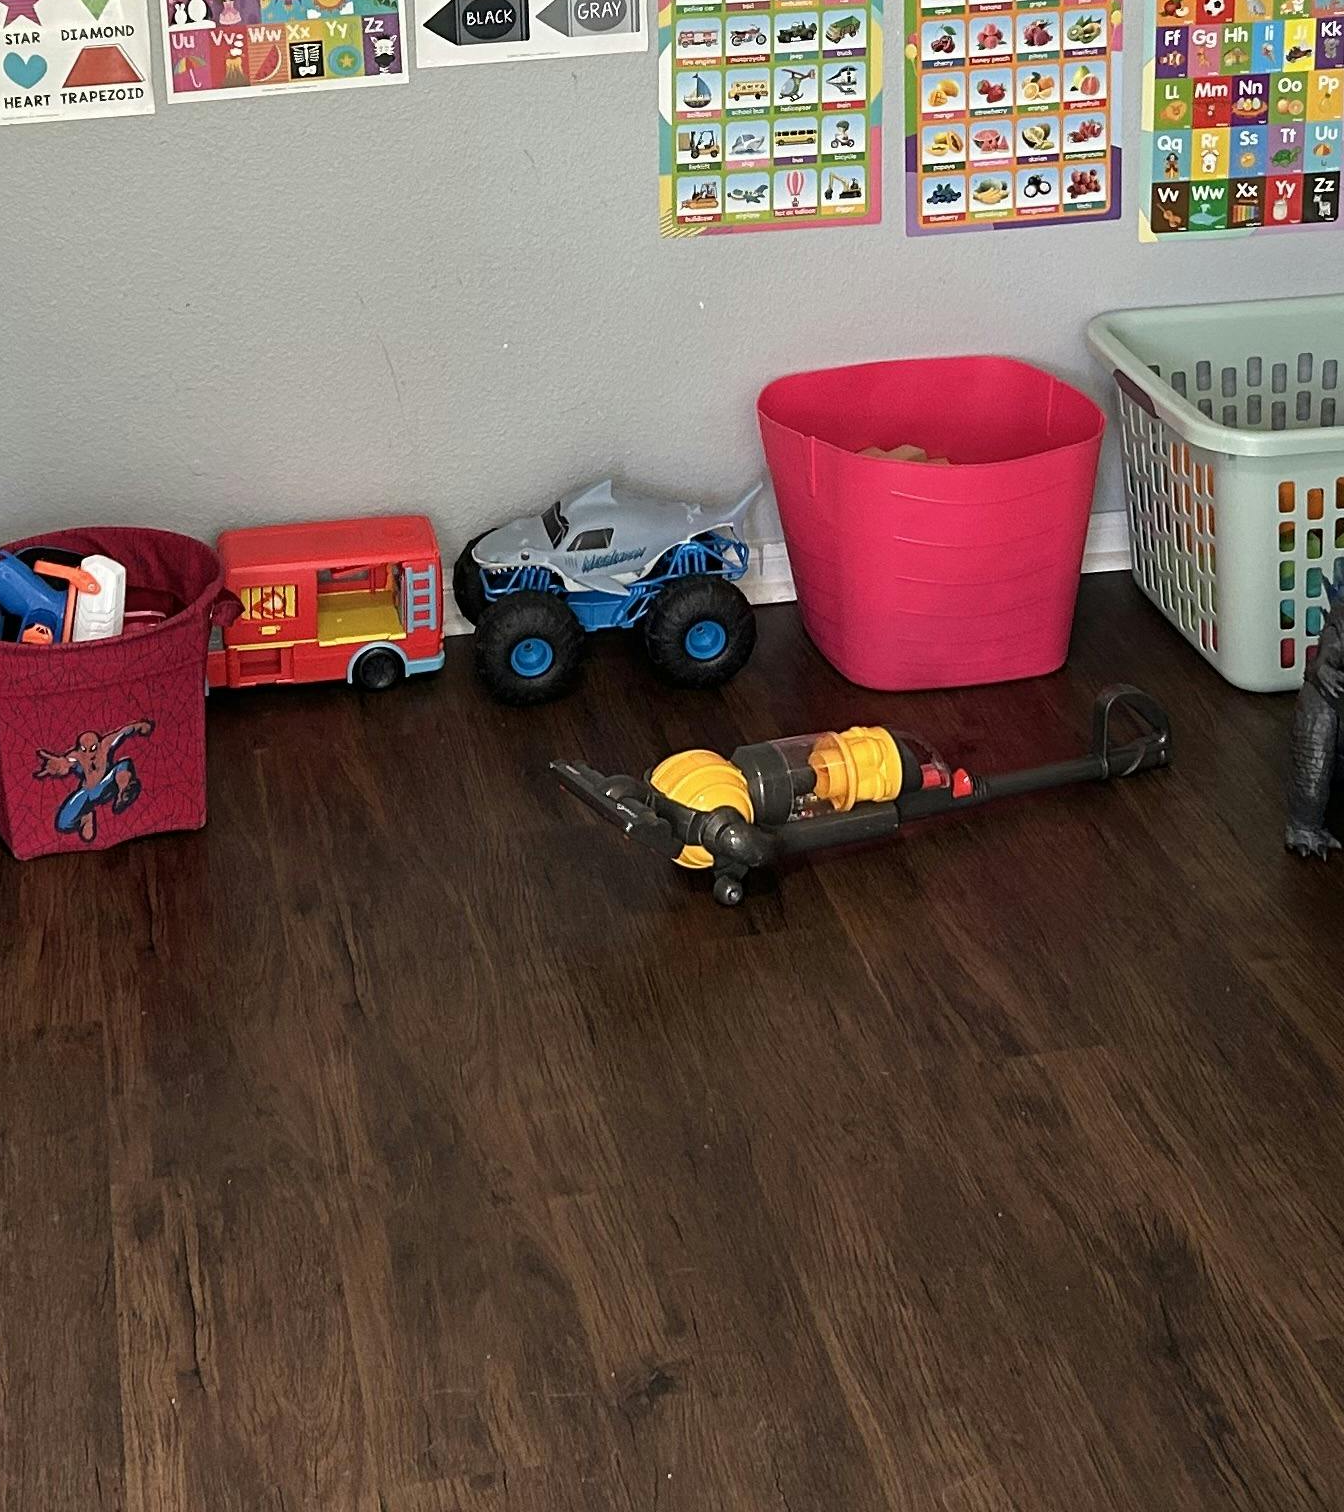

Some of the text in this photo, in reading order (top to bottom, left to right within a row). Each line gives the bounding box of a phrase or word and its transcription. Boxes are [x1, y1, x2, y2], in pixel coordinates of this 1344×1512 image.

[466, 10, 513, 26] BLACK
[577, 1, 621, 19] GRAY
[5, 32, 40, 46] STAR
[61, 25, 135, 41] DIAMOND
[4, 95, 50, 109] HEART
[60, 88, 144, 104] TRAPEZOID
